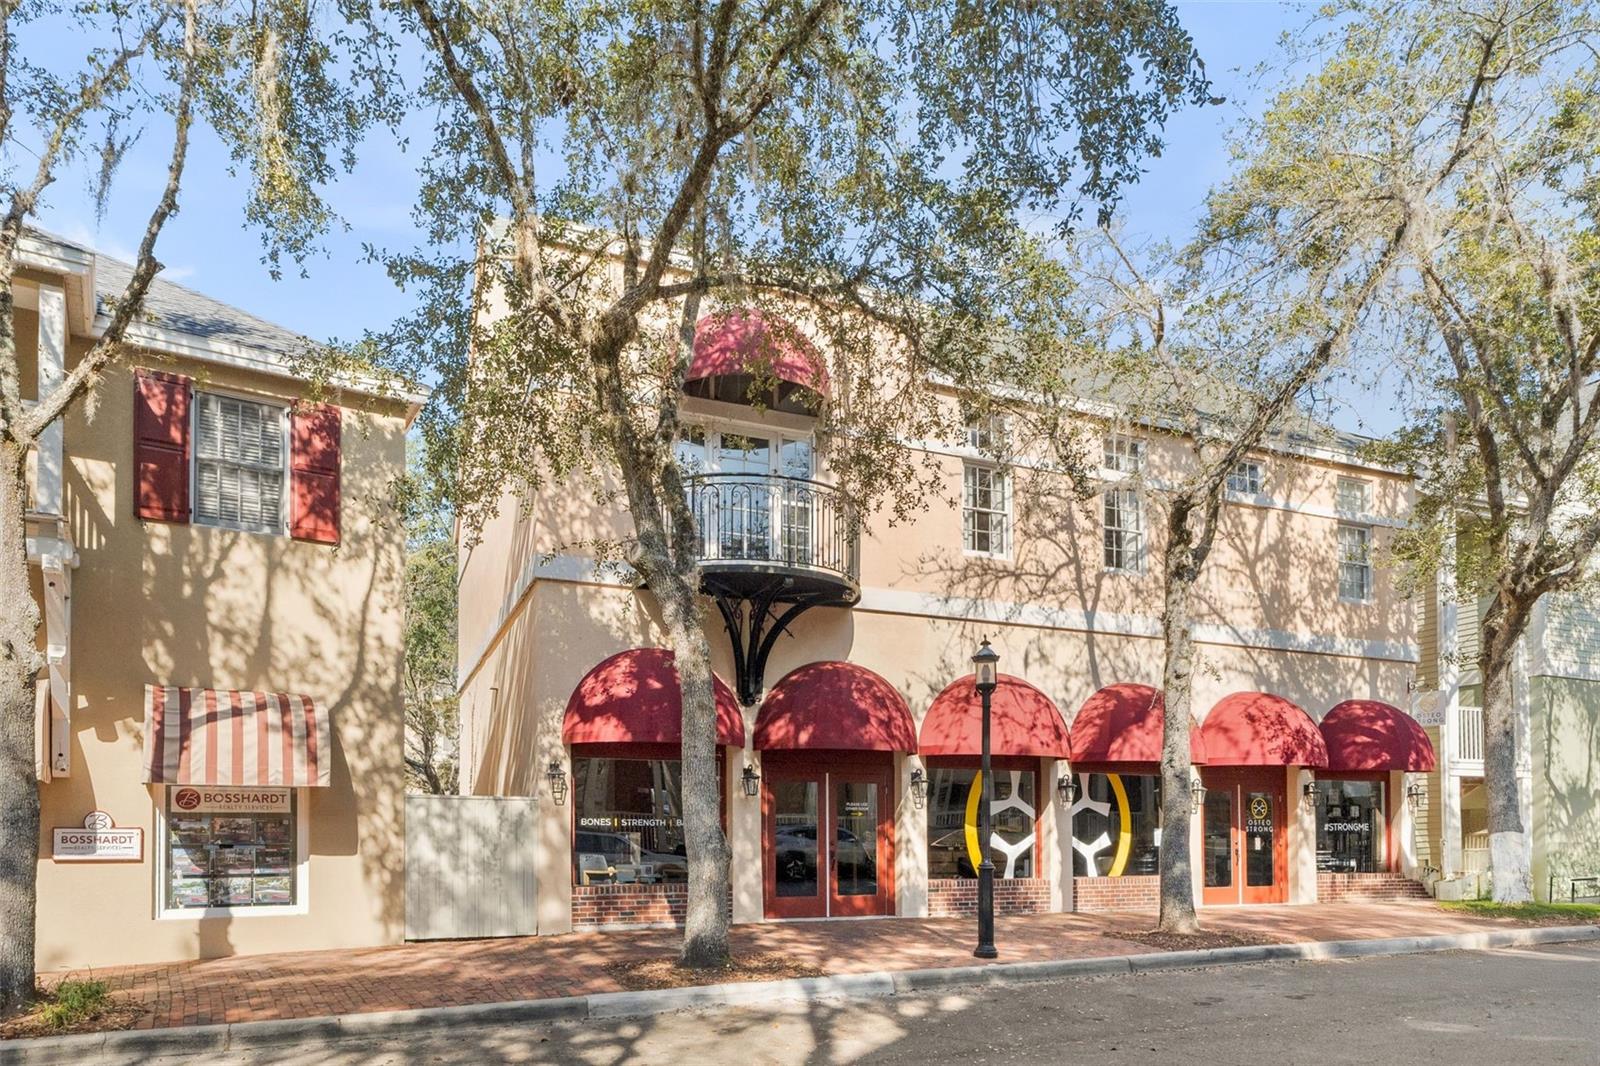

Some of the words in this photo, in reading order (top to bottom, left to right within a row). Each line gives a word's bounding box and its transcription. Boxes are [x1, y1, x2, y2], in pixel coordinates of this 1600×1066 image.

[204, 793, 287, 804] BOSSHARDT
[580, 818, 612, 826] BONES
[621, 818, 666, 827] STRENGTH
[1324, 823, 1369, 832] #STRONGME
[61, 835, 135, 844] BOSSHARDT
